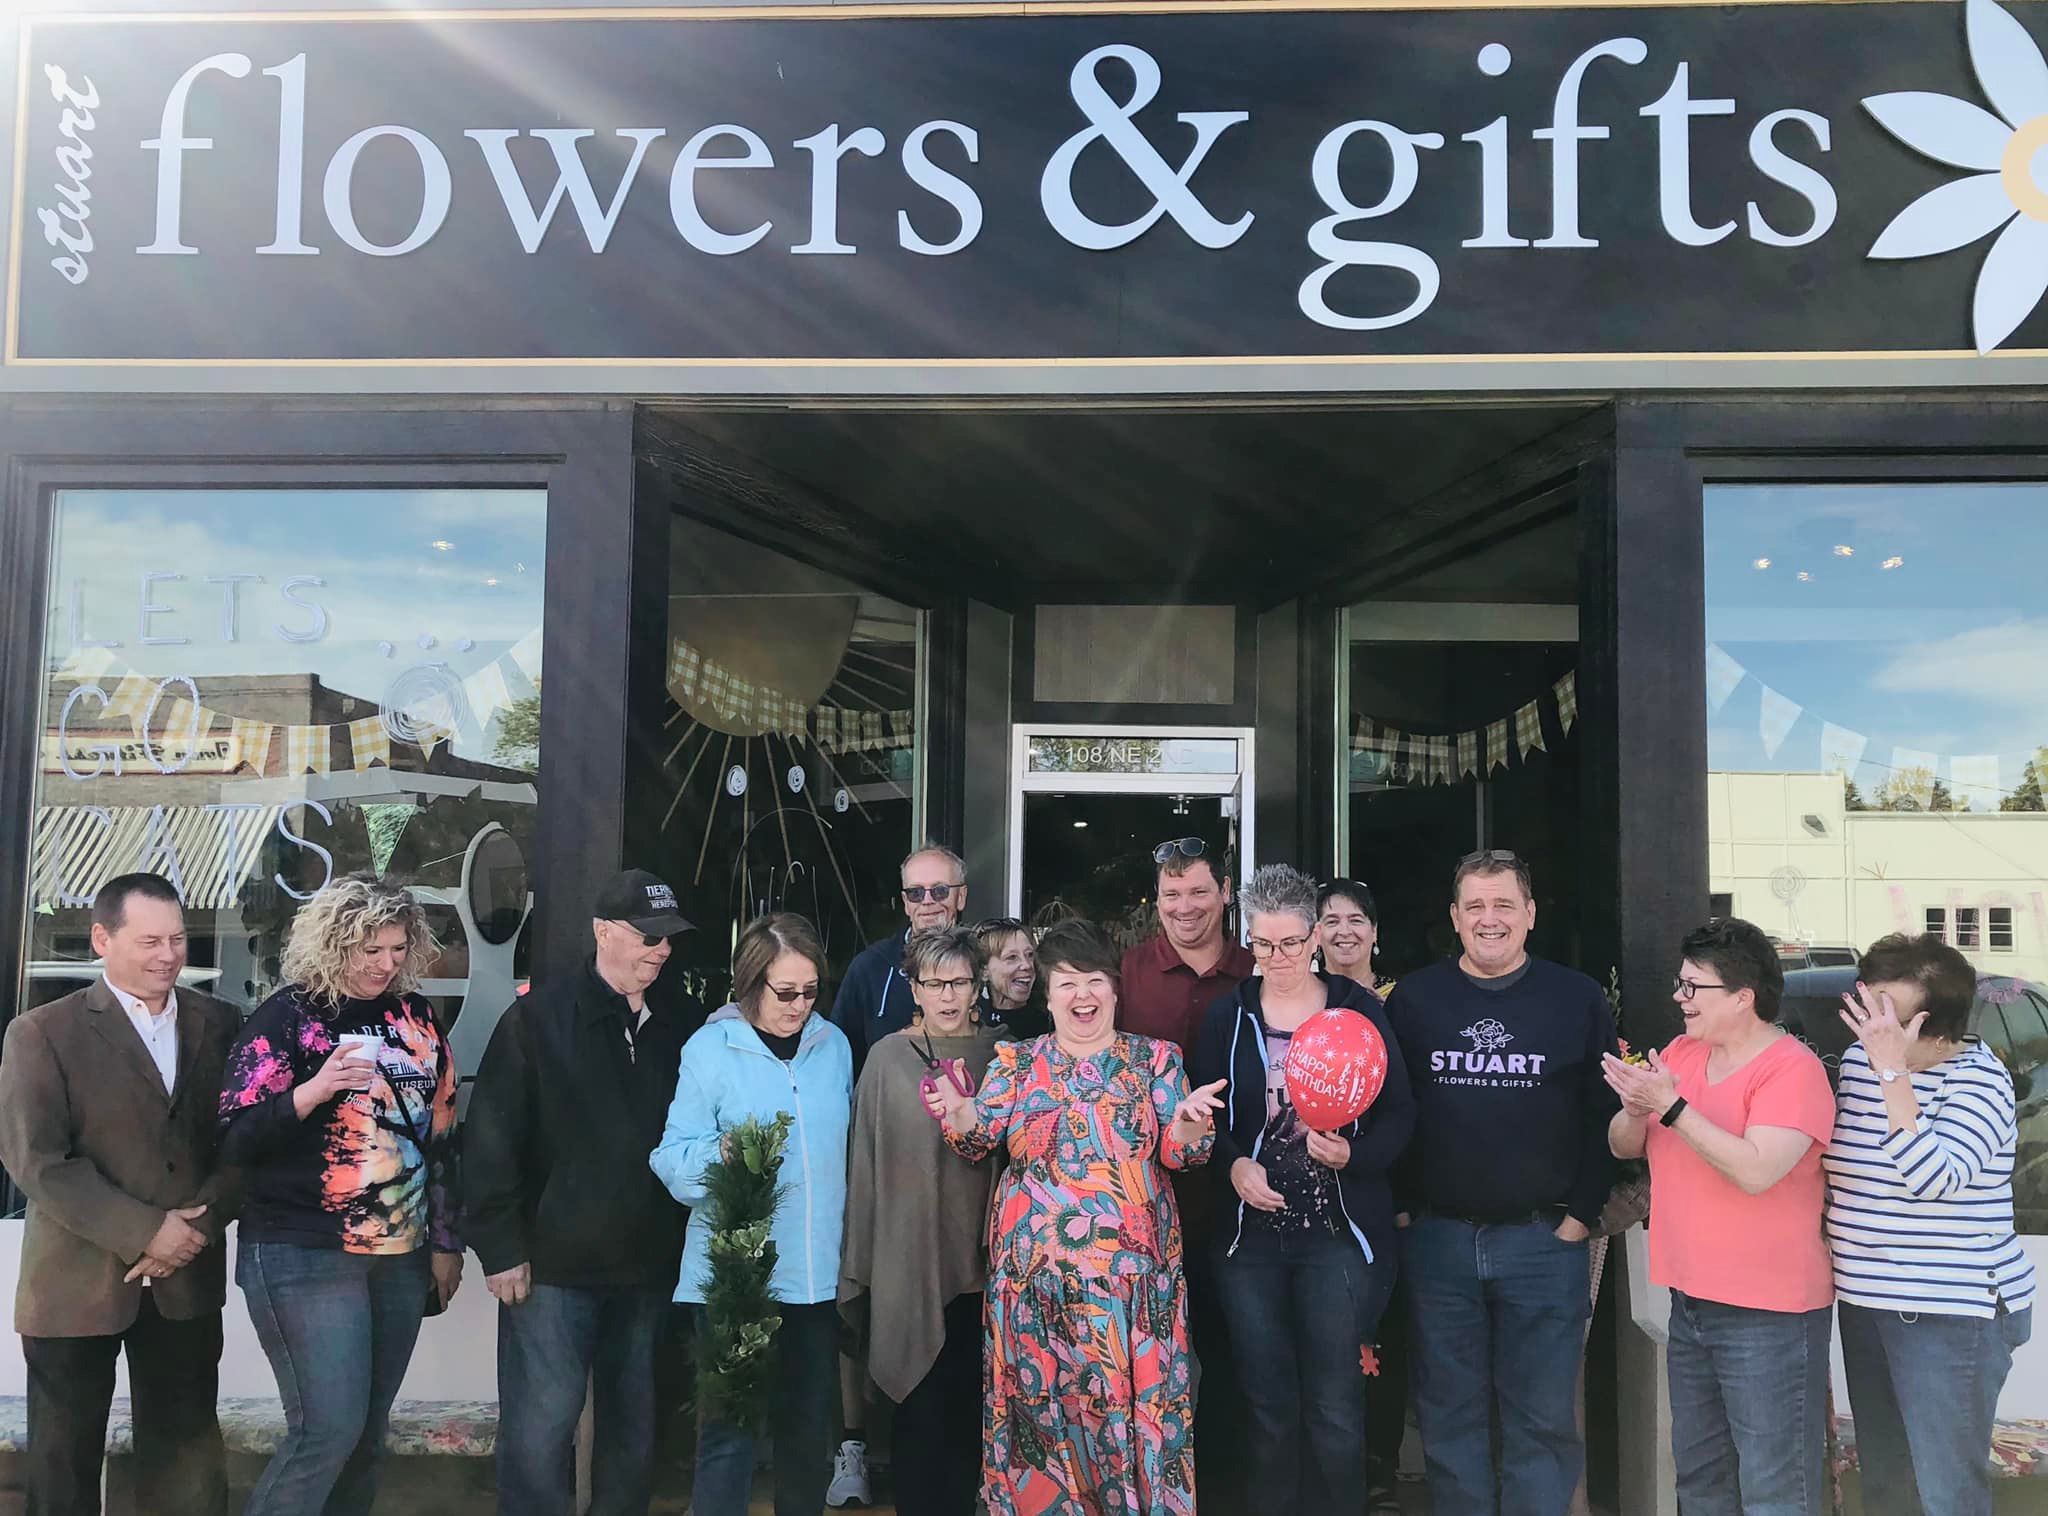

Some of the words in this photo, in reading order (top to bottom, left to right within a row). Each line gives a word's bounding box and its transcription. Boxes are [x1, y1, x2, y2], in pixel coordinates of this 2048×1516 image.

[36, 63, 101, 285] stuart
[136, 52, 984, 257] flowers
[1040, 43, 1257, 251] &
[1298, 37, 1839, 331] gifts
[69, 571, 329, 650] LETS
[58, 675, 201, 783] GO
[1065, 746, 1103, 764] 108
[1110, 747, 1142, 764] NE
[52, 799, 334, 904] CATS
[1291, 1063, 1342, 1098] BIRTHDAY
[1295, 1047, 1335, 1080] HAPPY
[1430, 1050, 1546, 1075] STUART
[1438, 1076, 1488, 1087] FLOWERS
[1502, 1079, 1533, 1088] GIFTS
